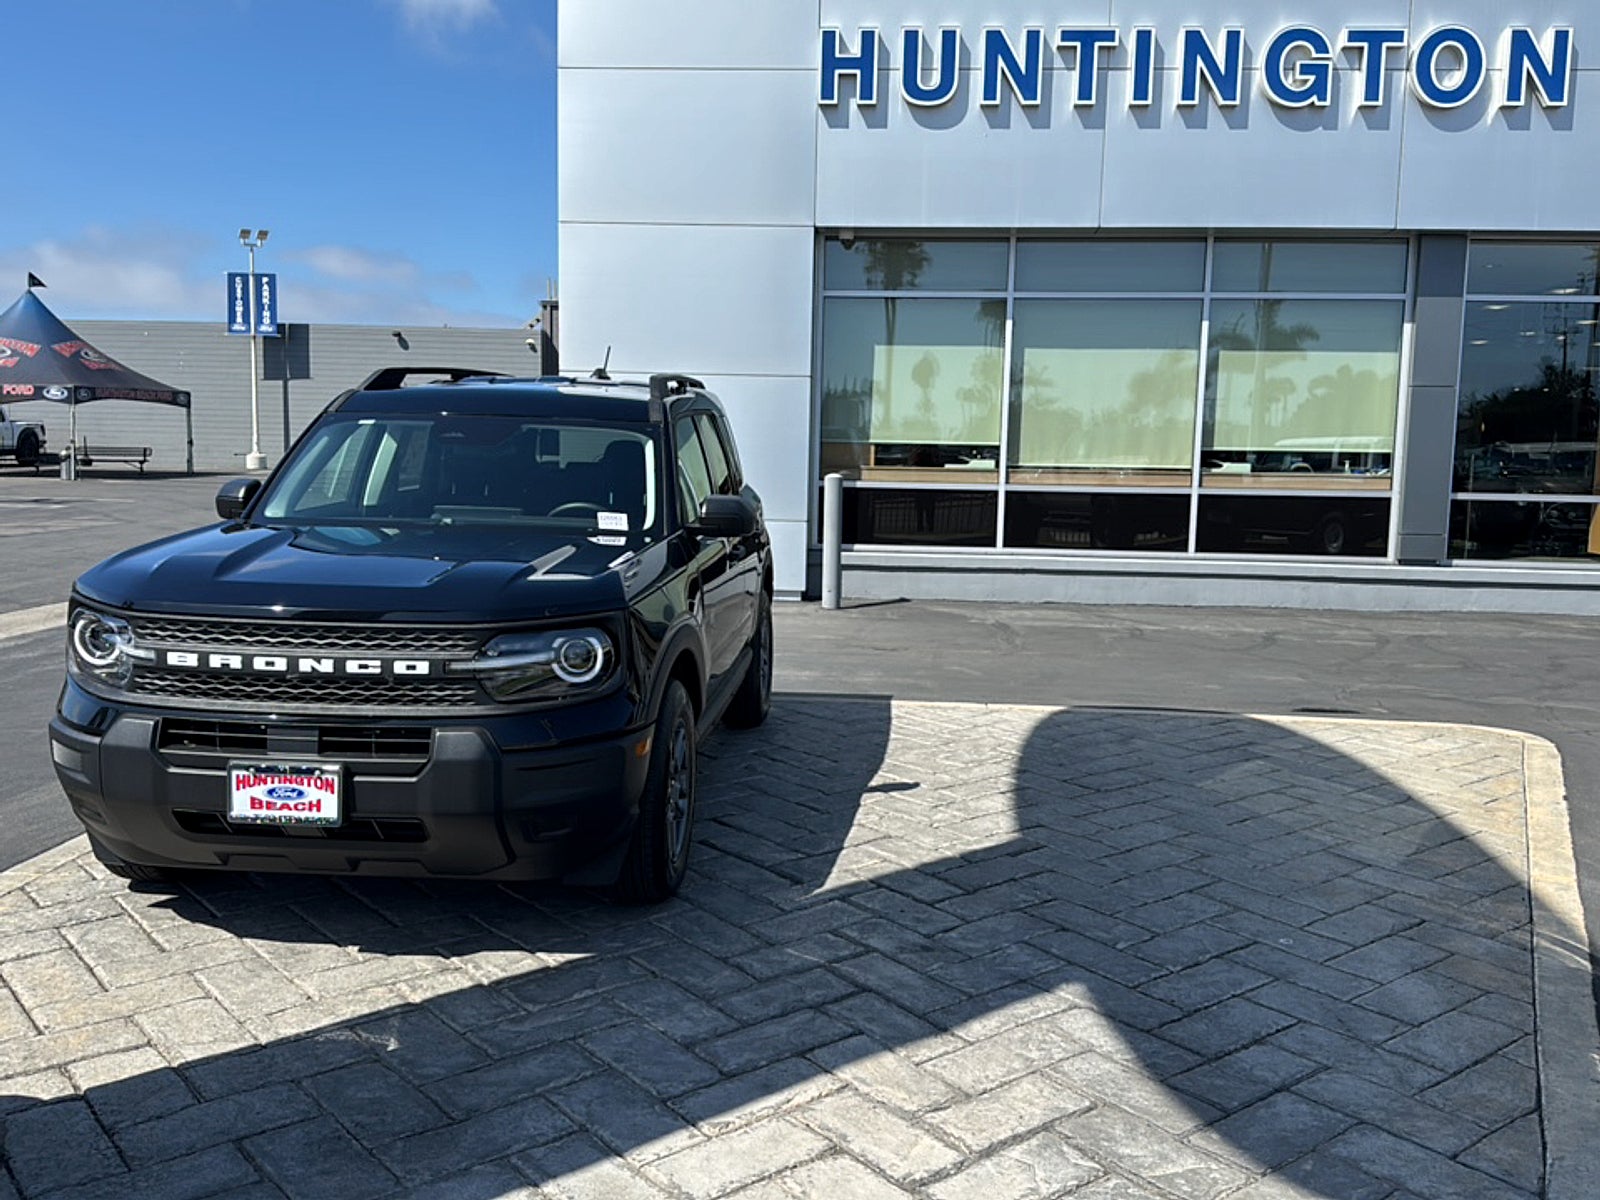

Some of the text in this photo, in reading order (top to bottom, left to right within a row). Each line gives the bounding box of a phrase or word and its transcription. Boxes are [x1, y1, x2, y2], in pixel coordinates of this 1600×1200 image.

[818, 26, 1574, 108] HUNTINGTON
[261, 276, 270, 325] PARKING
[3, 384, 35, 396] FORD
[166, 651, 430, 675] BRONCO
[235, 773, 335, 795] HUNTINGTON
[250, 796, 322, 813] BEACH
